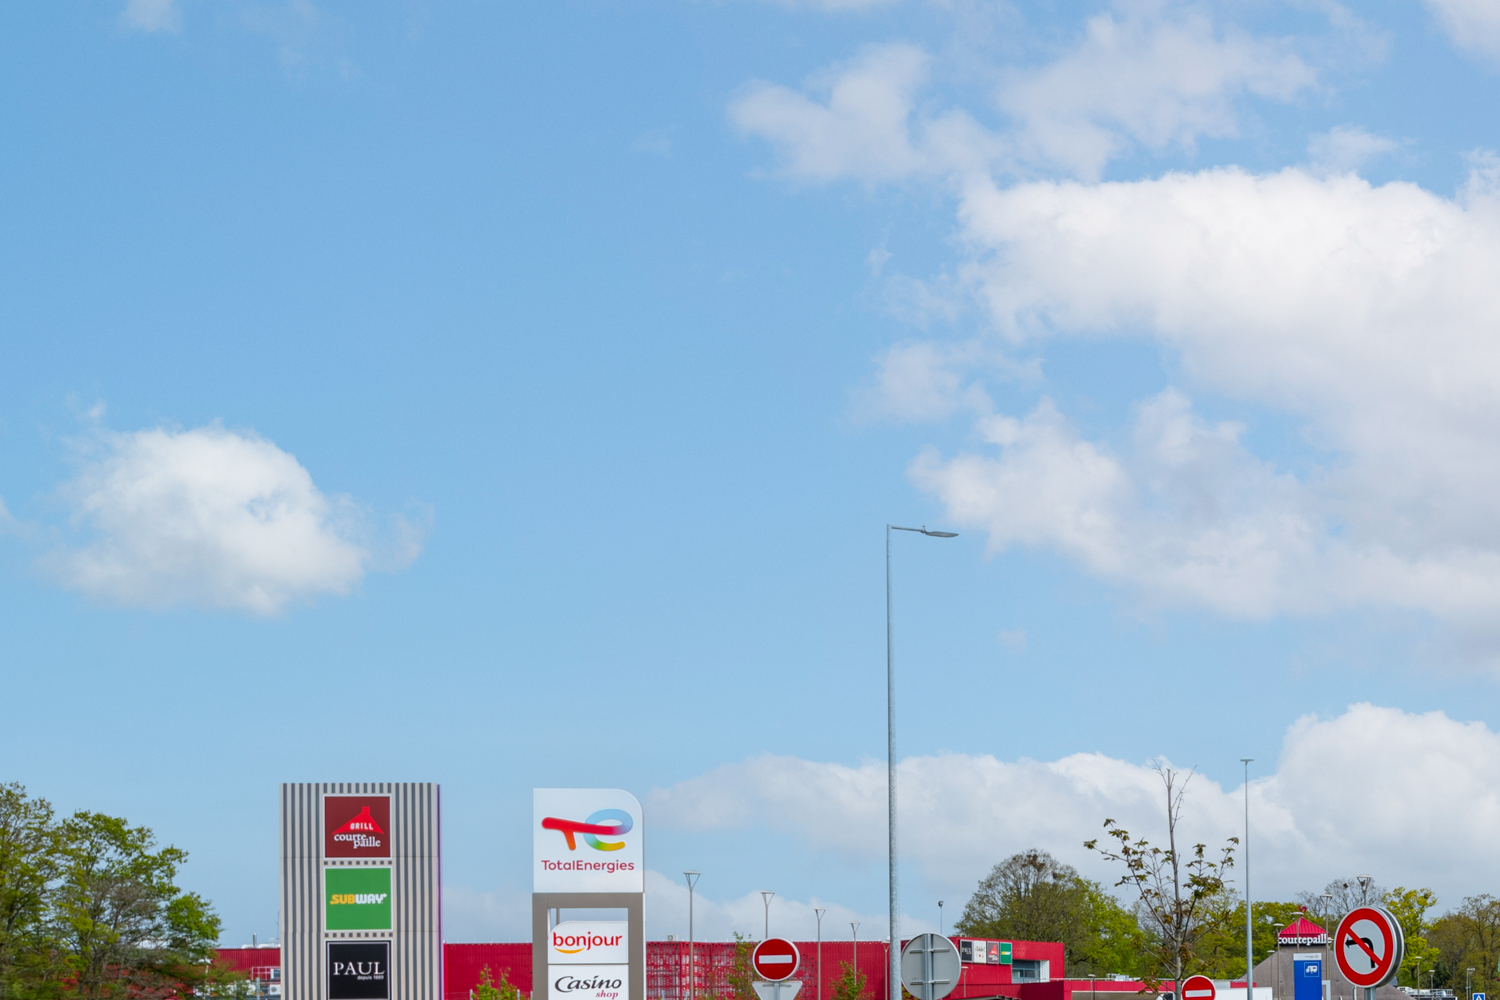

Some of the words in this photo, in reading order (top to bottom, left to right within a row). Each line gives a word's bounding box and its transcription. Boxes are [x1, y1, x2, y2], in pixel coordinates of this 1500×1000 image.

[350, 822, 373, 830] GRILL
[353, 836, 381, 849] paille
[541, 859, 635, 874] TotalEnergies
[330, 893, 387, 905] SUBWAY
[553, 931, 623, 950] bonjour
[333, 962, 385, 975] PAUL
[554, 975, 622, 993] Casino
[595, 989, 619, 1000] shop
